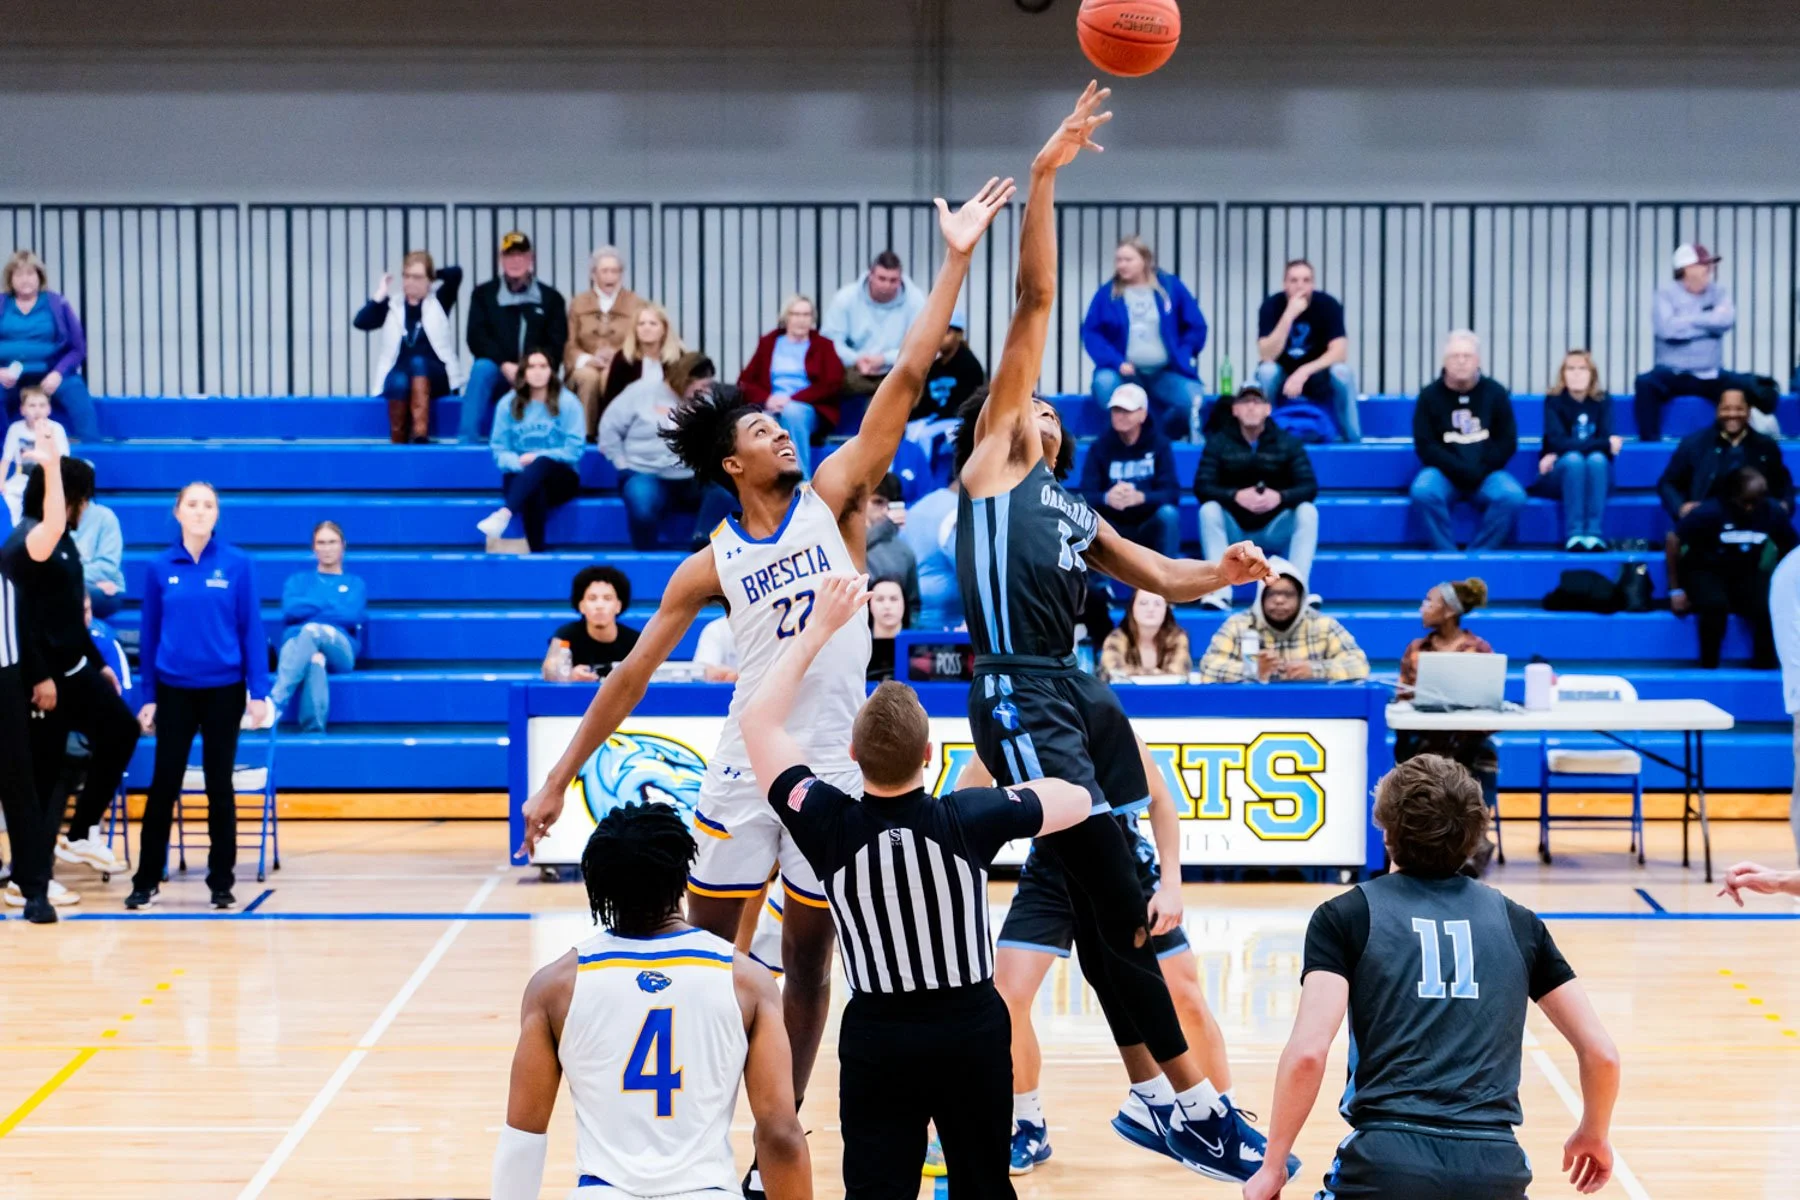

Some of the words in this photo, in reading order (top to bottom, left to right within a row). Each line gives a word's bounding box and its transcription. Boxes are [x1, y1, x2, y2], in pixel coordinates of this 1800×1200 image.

[741, 545, 831, 605] BRESCIA
[1411, 917, 1479, 999] 11
[620, 1005, 684, 1119] 4
